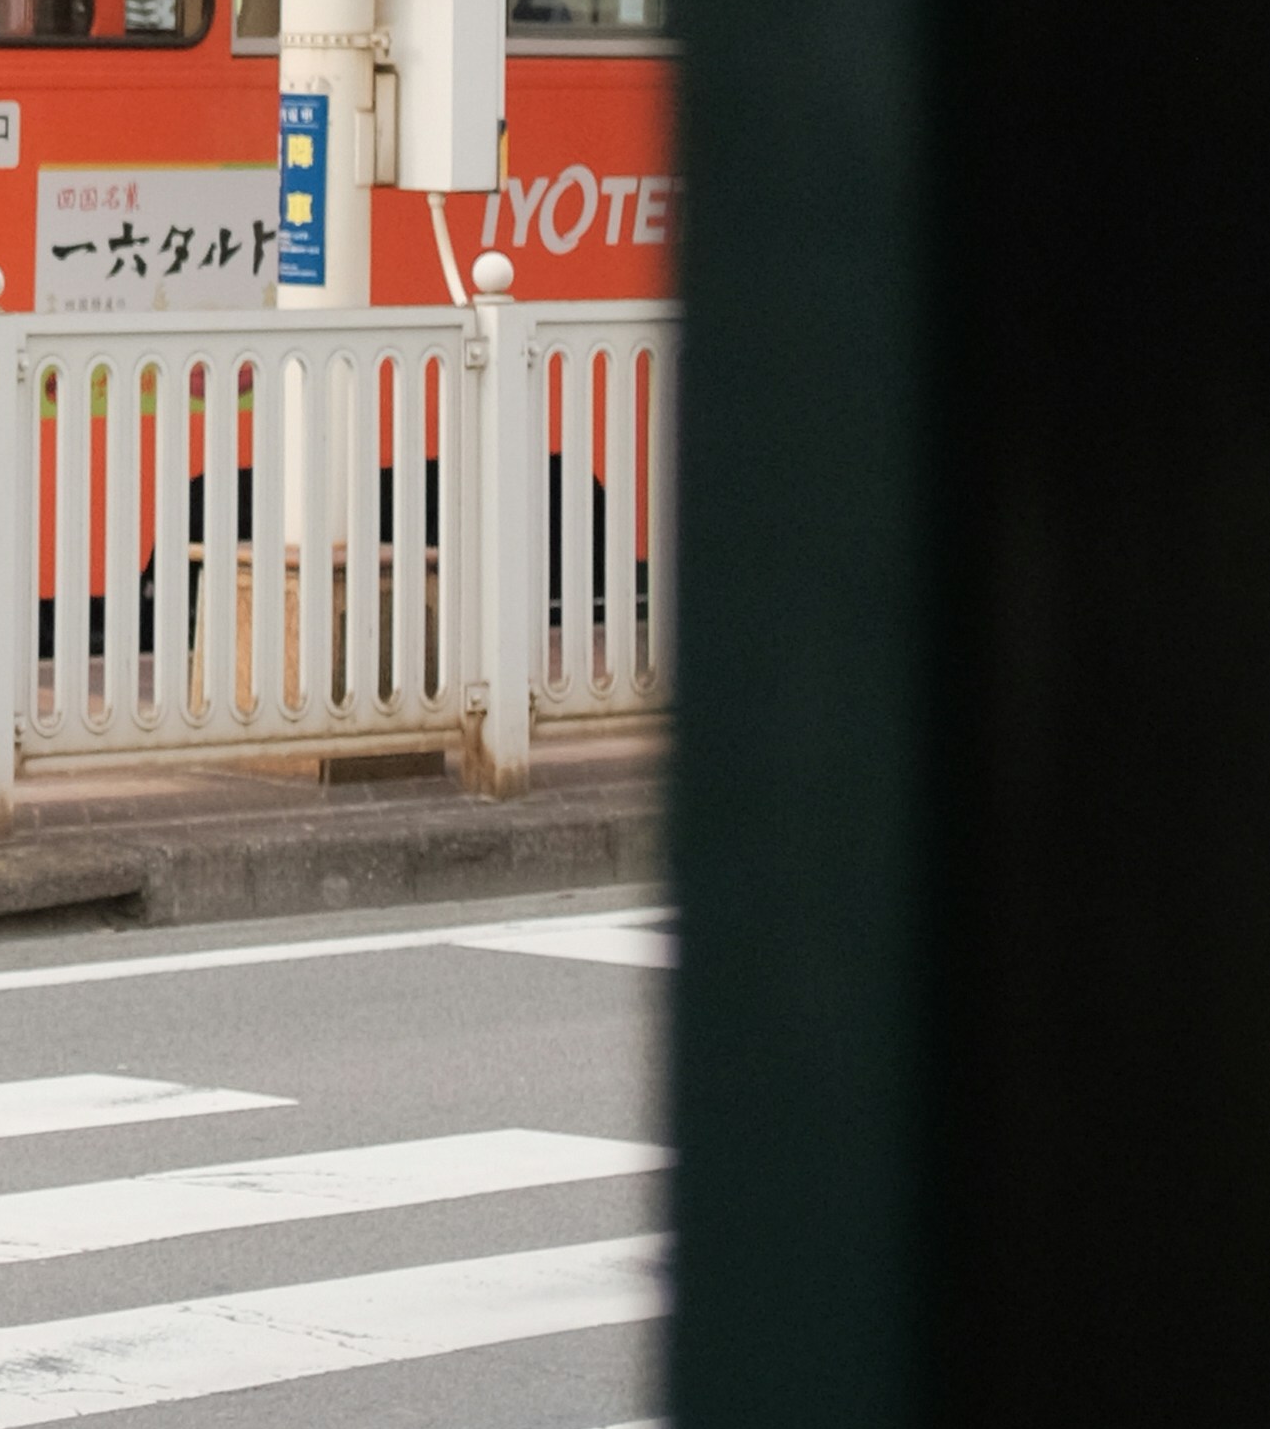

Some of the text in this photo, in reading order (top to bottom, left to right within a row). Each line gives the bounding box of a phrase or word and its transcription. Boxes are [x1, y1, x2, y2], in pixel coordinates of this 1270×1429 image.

[481, 164, 673, 255] IYOTE
[52, 219, 277, 278] 一六タルト
